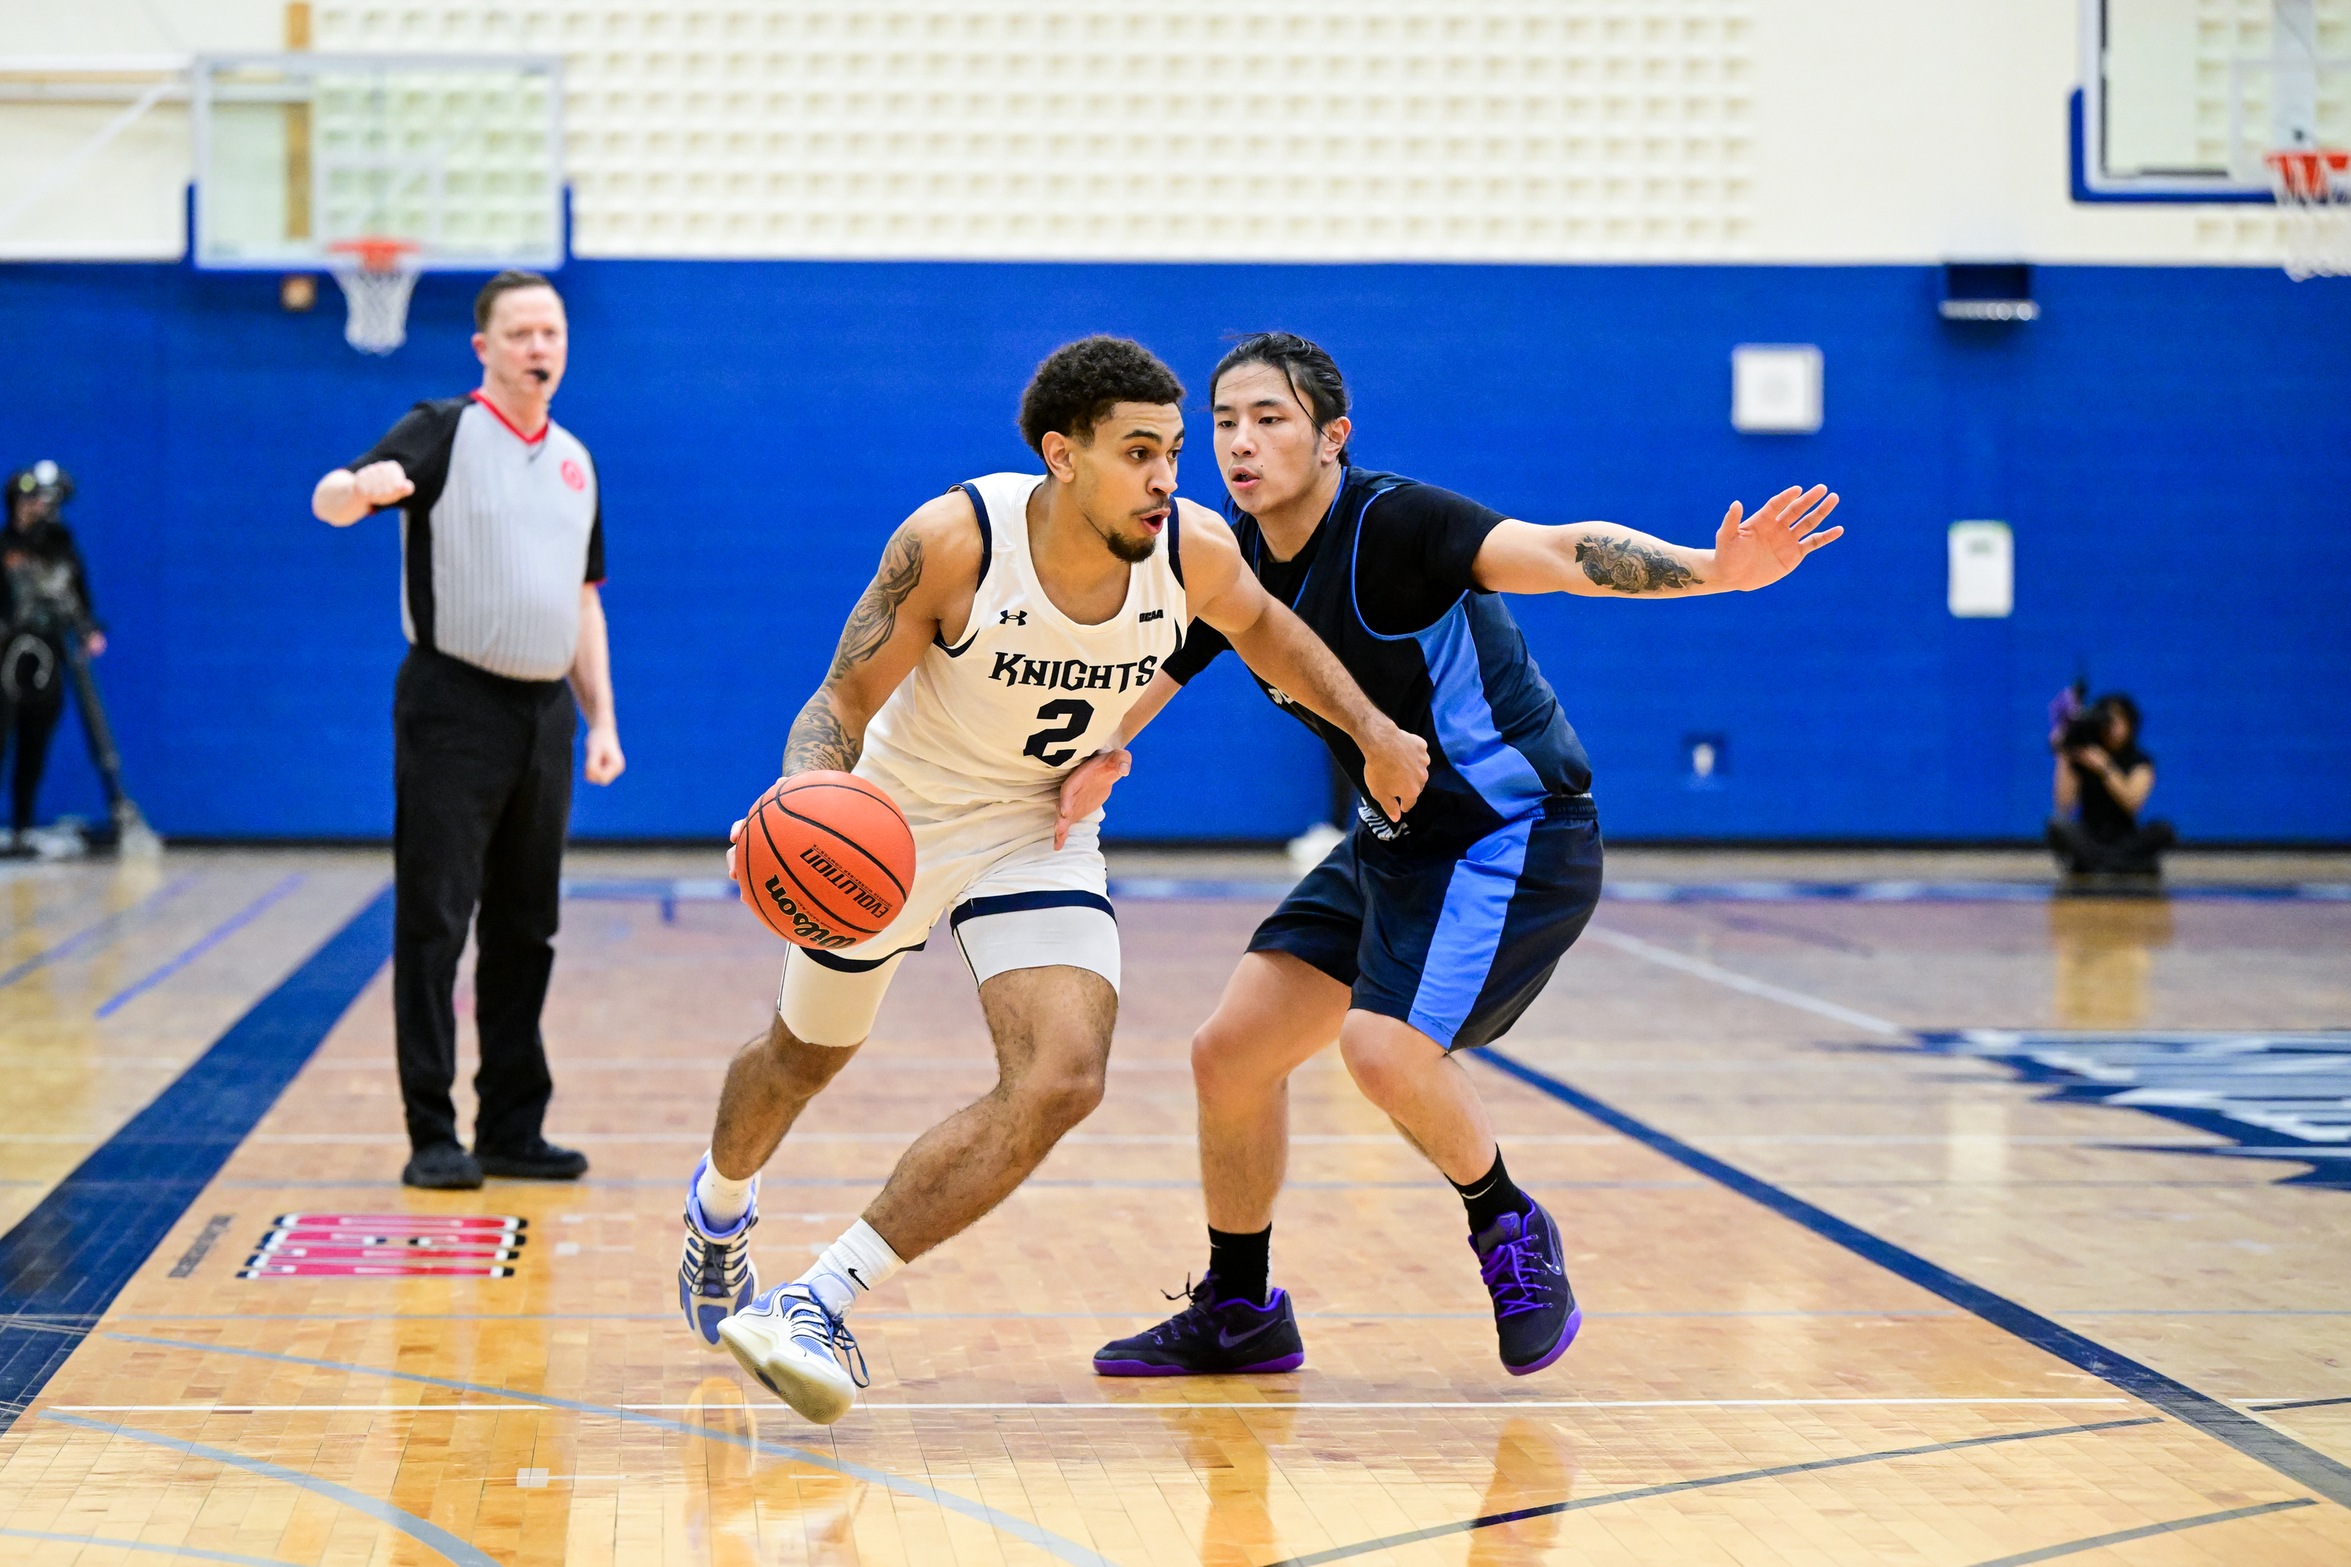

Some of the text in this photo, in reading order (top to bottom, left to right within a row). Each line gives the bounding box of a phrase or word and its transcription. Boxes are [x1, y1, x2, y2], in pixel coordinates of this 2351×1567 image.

[988, 651, 1158, 694] KNIGHTS
[1023, 699, 1095, 767] 2
[765, 874, 857, 949] Wilson
[799, 848, 890, 919] EVOLUTION
